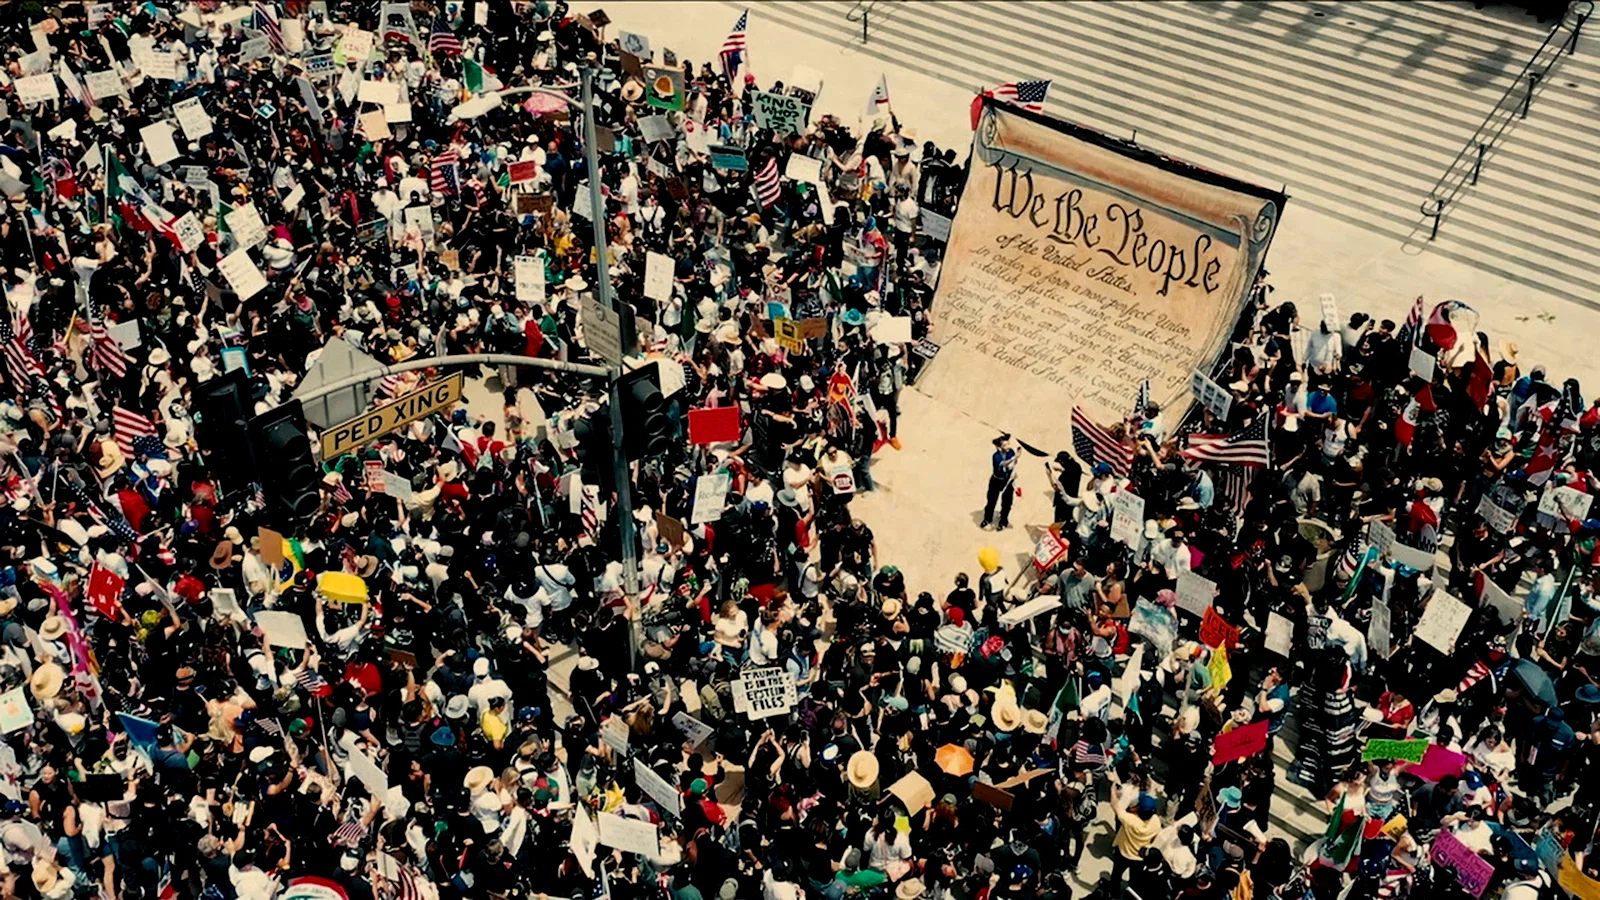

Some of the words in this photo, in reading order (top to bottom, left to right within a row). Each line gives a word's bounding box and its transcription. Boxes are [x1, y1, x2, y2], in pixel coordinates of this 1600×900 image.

[755, 93, 797, 110] KING
[985, 153, 1049, 228] We
[1047, 189, 1101, 248] the
[1099, 204, 1221, 297] People
[995, 234, 1022, 249] of
[1014, 238, 1039, 256] the
[1042, 244, 1092, 272] United
[992, 254, 1024, 272] order
[1028, 264, 1042, 278] to
[1036, 270, 1070, 289] form
[1071, 284, 1081, 293] a
[1080, 287, 1105, 304] more
[1100, 299, 1156, 321] perfect
[971, 261, 1021, 285] establish
[1114, 316, 1161, 341] domestic
[993, 346, 1038, 370] United
[335, 415, 383, 450] PED
[394, 384, 450, 424] XING
[742, 669, 781, 680] TRUMP
[744, 681, 754, 690] IS
[755, 680, 766, 689] IN
[767, 677, 784, 686] THE
[746, 686, 785, 701] EPSTEIN
[753, 696, 784, 711] FILES
